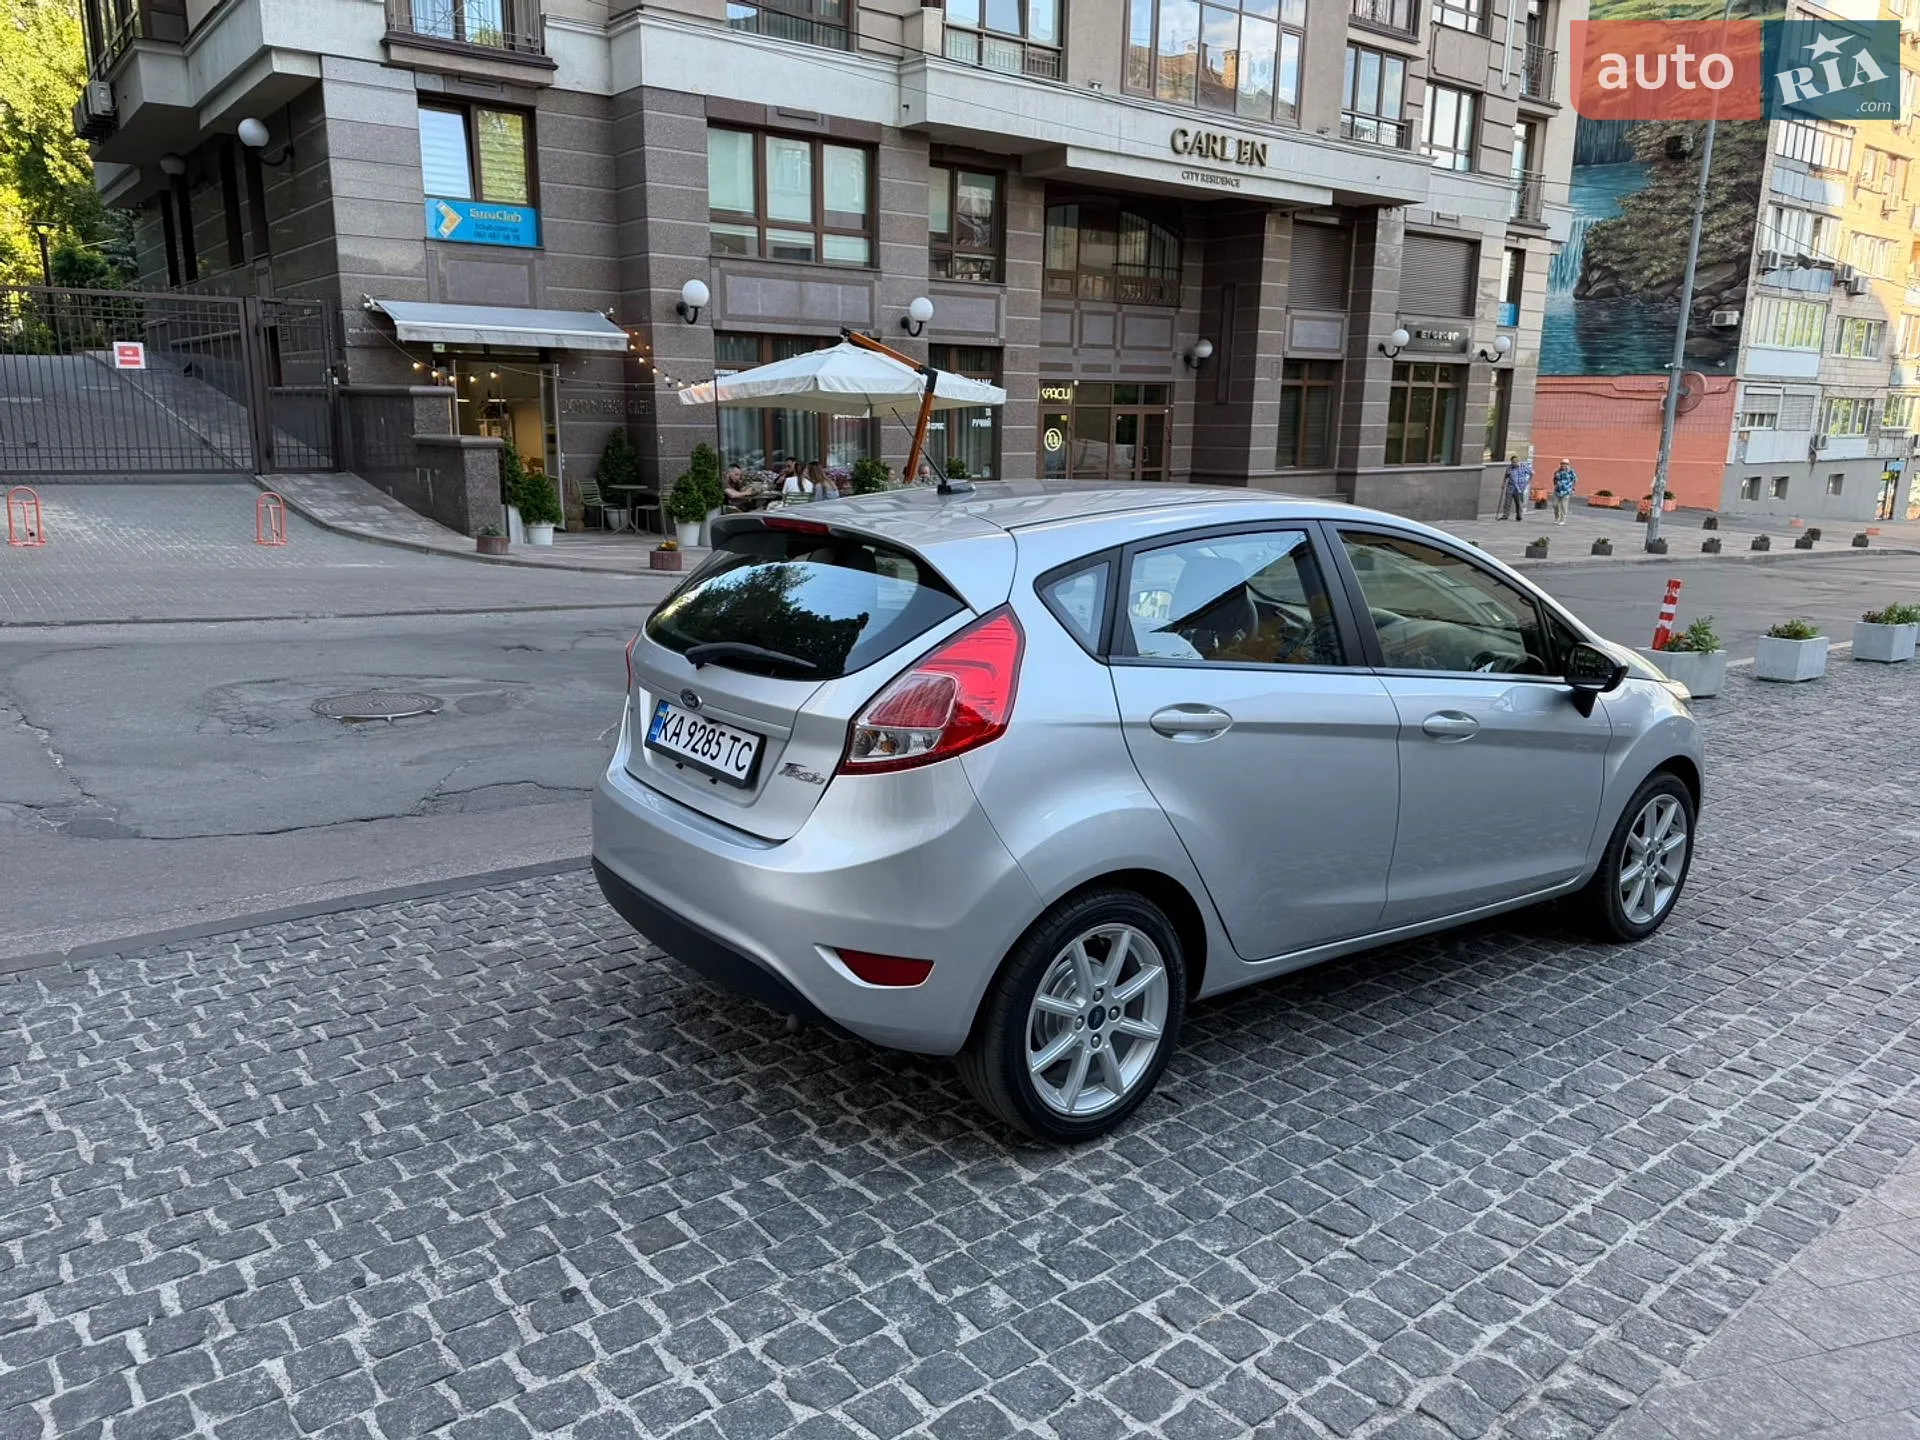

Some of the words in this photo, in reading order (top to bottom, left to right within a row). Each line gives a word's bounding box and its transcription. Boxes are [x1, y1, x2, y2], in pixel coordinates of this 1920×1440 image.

[1170, 128, 1267, 168] GARDEN
[1181, 171, 1200, 181] CITY
[1200, 172, 1241, 188] RESIDENCE
[658, 711, 685, 746] KA
[683, 721, 726, 761] 9285
[724, 735, 753, 772] TC
